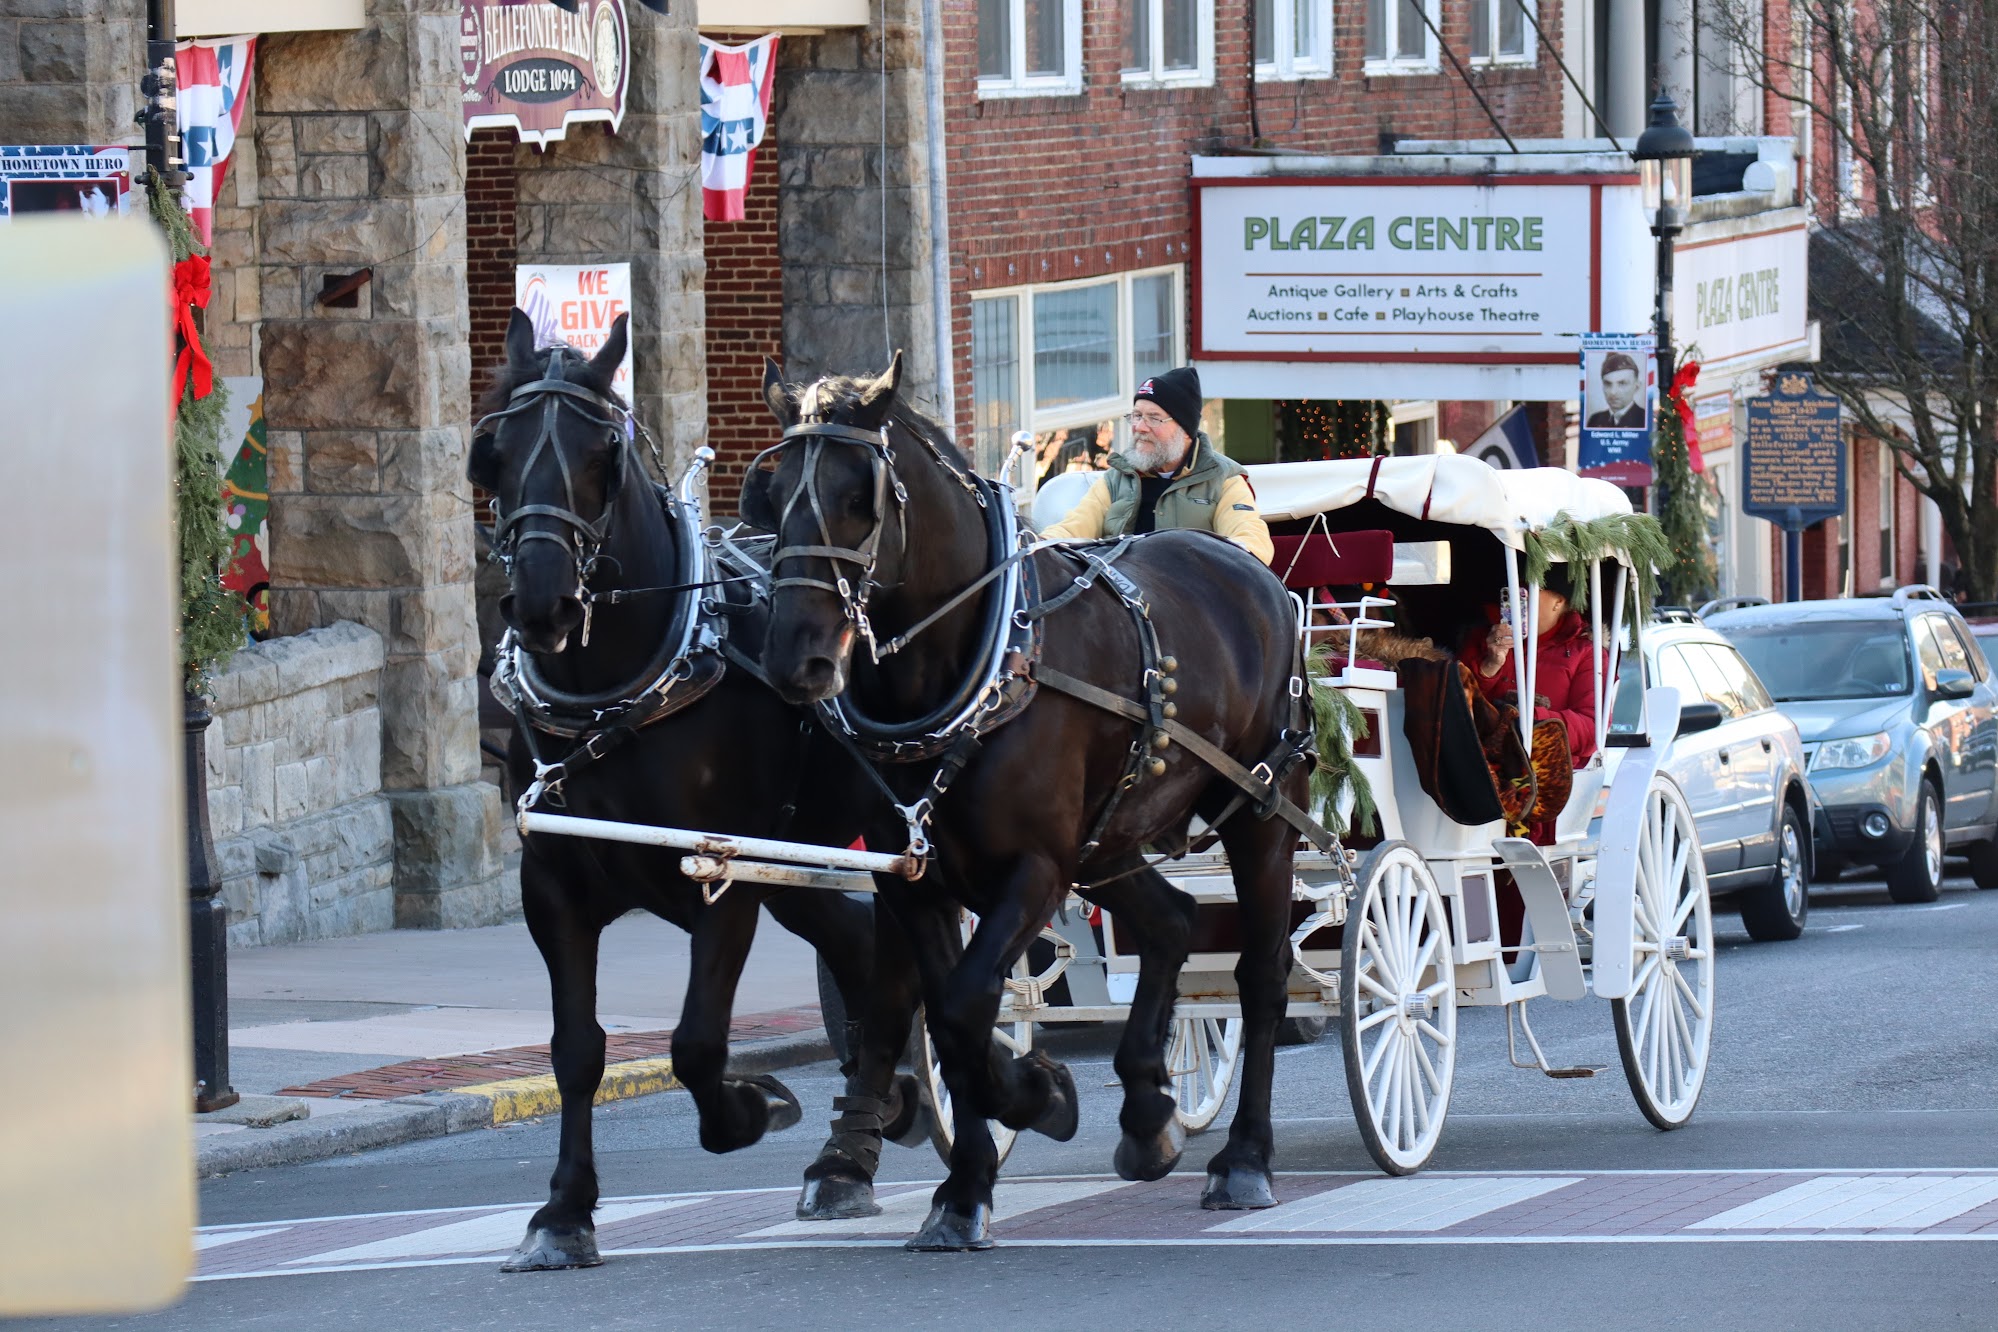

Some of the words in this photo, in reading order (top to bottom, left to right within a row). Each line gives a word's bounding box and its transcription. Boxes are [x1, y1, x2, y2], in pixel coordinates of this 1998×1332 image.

[484, 5, 558, 65] BELLEFONTE
[561, 2, 591, 61] ELKS
[505, 69, 546, 93] LODGE
[550, 69, 576, 91] 1094
[2, 158, 80, 170] HOMETOWN
[85, 158, 123, 170] HERO
[1244, 216, 1374, 250] PLAZA
[1388, 216, 1543, 250] CENTRE
[577, 270, 609, 295] WE
[1268, 284, 1328, 301] Antique
[1334, 283, 1394, 300] Gallery
[1416, 284, 1447, 298] Arts
[1453, 284, 1465, 298] &
[1471, 283, 1518, 298] Crafts
[1697, 275, 1732, 331] PLAZA
[1737, 267, 1778, 321] CENTRE
[561, 299, 623, 330] GIVE
[1248, 307, 1313, 321] Auctions
[1334, 306, 1369, 321] Cafe
[1392, 307, 1474, 324] Playhouse
[1480, 307, 1540, 321] Theatre
[567, 334, 598, 348] BACK
[1612, 439, 1629, 447] Army
